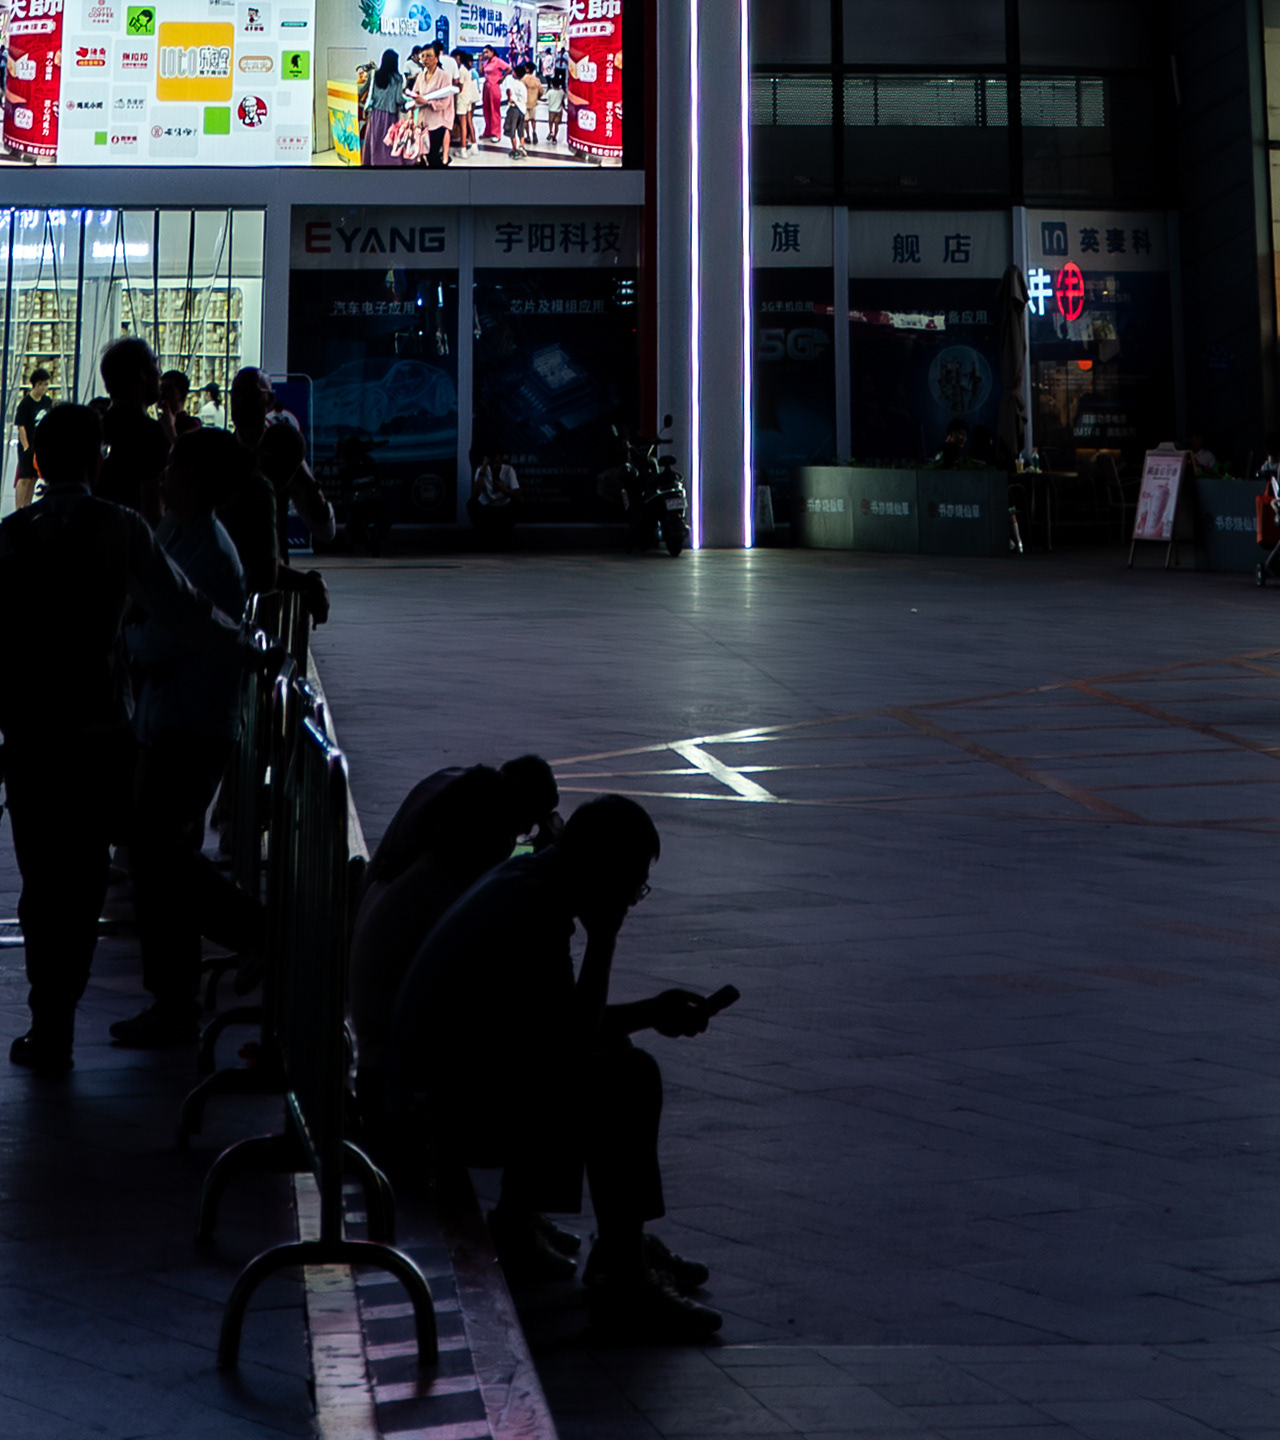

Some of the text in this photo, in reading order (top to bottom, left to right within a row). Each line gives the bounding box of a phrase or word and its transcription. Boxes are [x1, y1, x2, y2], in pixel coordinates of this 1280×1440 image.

[306, 221, 446, 254] EYANG
[495, 221, 623, 254] 宇阳科技
[1079, 227, 1153, 255] 英麦科
[332, 299, 417, 316] 汽车电子应用
[510, 299, 607, 314] 芯片及模组应用
[761, 300, 816, 314] 5G手机应用
